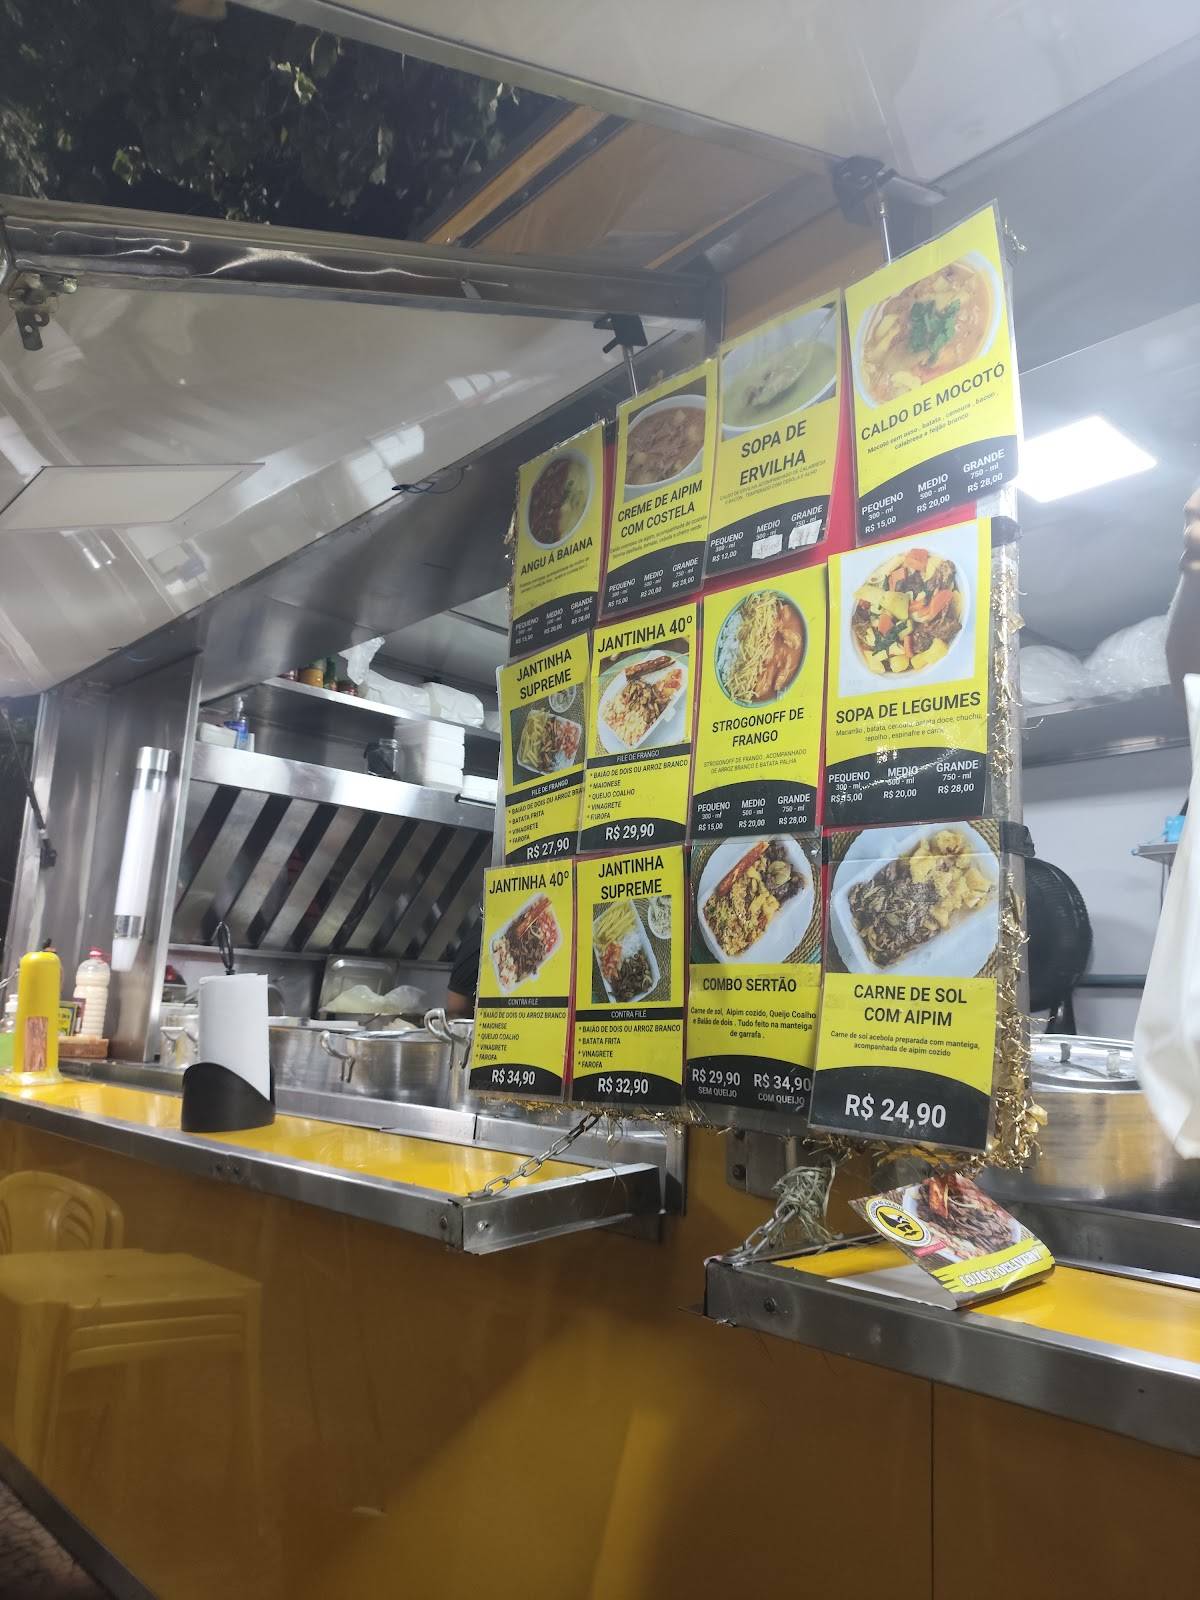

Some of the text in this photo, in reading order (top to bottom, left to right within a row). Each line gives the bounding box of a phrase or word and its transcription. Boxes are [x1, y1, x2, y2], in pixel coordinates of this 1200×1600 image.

[861, 363, 1005, 440] CALDO DE MOCOTÓ
[741, 420, 807, 458] SOPA DE
[740, 449, 806, 486] ERVILHA
[862, 448, 1005, 515] PEQUENO MEDIO GRANDE
[618, 500, 652, 522] CREME
[654, 493, 668, 509] DE
[670, 480, 703, 502] AIPIM
[868, 463, 999, 521] 300 ml 500 ml 750 ml
[865, 473, 1003, 535] R$ 15,00 R$ 20,00 R$ 28,00
[621, 520, 644, 538] COM
[646, 501, 695, 528] COSTELA
[710, 505, 823, 547] PEQUENO MEDIO GRANDE
[521, 559, 546, 576] ANGU
[556, 536, 593, 560] BAIANA
[721, 550, 737, 560] 12,00
[608, 578, 636, 592] PEQUENO
[672, 557, 699, 572] GRANDE
[598, 623, 666, 653] JANTINHA
[516, 649, 572, 682] JANTINHA
[520, 668, 572, 700] SUPREME
[836, 691, 981, 724] SOPA DE LEGUMES
[712, 707, 804, 733] STROGONOFF DE
[732, 729, 778, 747] FRANGO
[637, 750, 660, 759] FRANGO
[642, 762, 662, 772] ARROZ
[663, 759, 688, 769] BRANCO
[828, 771, 871, 783] PEQUENO
[936, 760, 979, 773] GRANDE
[548, 779, 569, 790] FRANGO
[593, 780, 621, 789] MAIONESE
[942, 771, 972, 781] 750 ml
[592, 788, 635, 801] QUEIJO COALHO
[883, 790, 894, 800] R$
[895, 788, 917, 799] 20,00
[938, 784, 949, 795] R$
[950, 783, 975, 795] 28,00
[591, 801, 622, 810] VINAGRETE
[697, 793, 811, 812] PEQUENO MEDIO GRANDE
[512, 810, 545, 824] BATATA FRITA
[698, 815, 807, 832] R$ 15,00 R$ 20,00 R$ 28,00
[606, 823, 655, 840] R$ 29,90
[527, 837, 570, 860] R$ 27,90
[598, 855, 664, 878] JANTINHA
[489, 874, 546, 894] JANTINHA
[601, 878, 662, 900] SUPREME
[703, 976, 797, 992] COMBO SERTÃO
[854, 984, 968, 1004] CARNE DE SOL
[737, 1019, 754, 1027] Tudo
[755, 1020, 769, 1028] feito
[780, 1021, 813, 1031] manteiga
[769, 1010, 790, 1020] Queijo
[792, 1011, 817, 1019] Coalho
[864, 1007, 952, 1027] COM AIPIM
[654, 1024, 680, 1032] BRANCO
[830, 1030, 848, 1038] Carne
[894, 1036, 928, 1045] preparada
[582, 1050, 614, 1058] VINAGRETE
[908, 1046, 927, 1055] aipim
[928, 1049, 951, 1057] cozido
[492, 1068, 535, 1087] R$ 34,90
[598, 1077, 649, 1097] R$ 32,90
[692, 1067, 812, 1093] R$ 29,90 R$ 34,90
[698, 1086, 805, 1106] SEM QUEIJO COM QUEIJO
[845, 1093, 947, 1129] R$ 24,90
